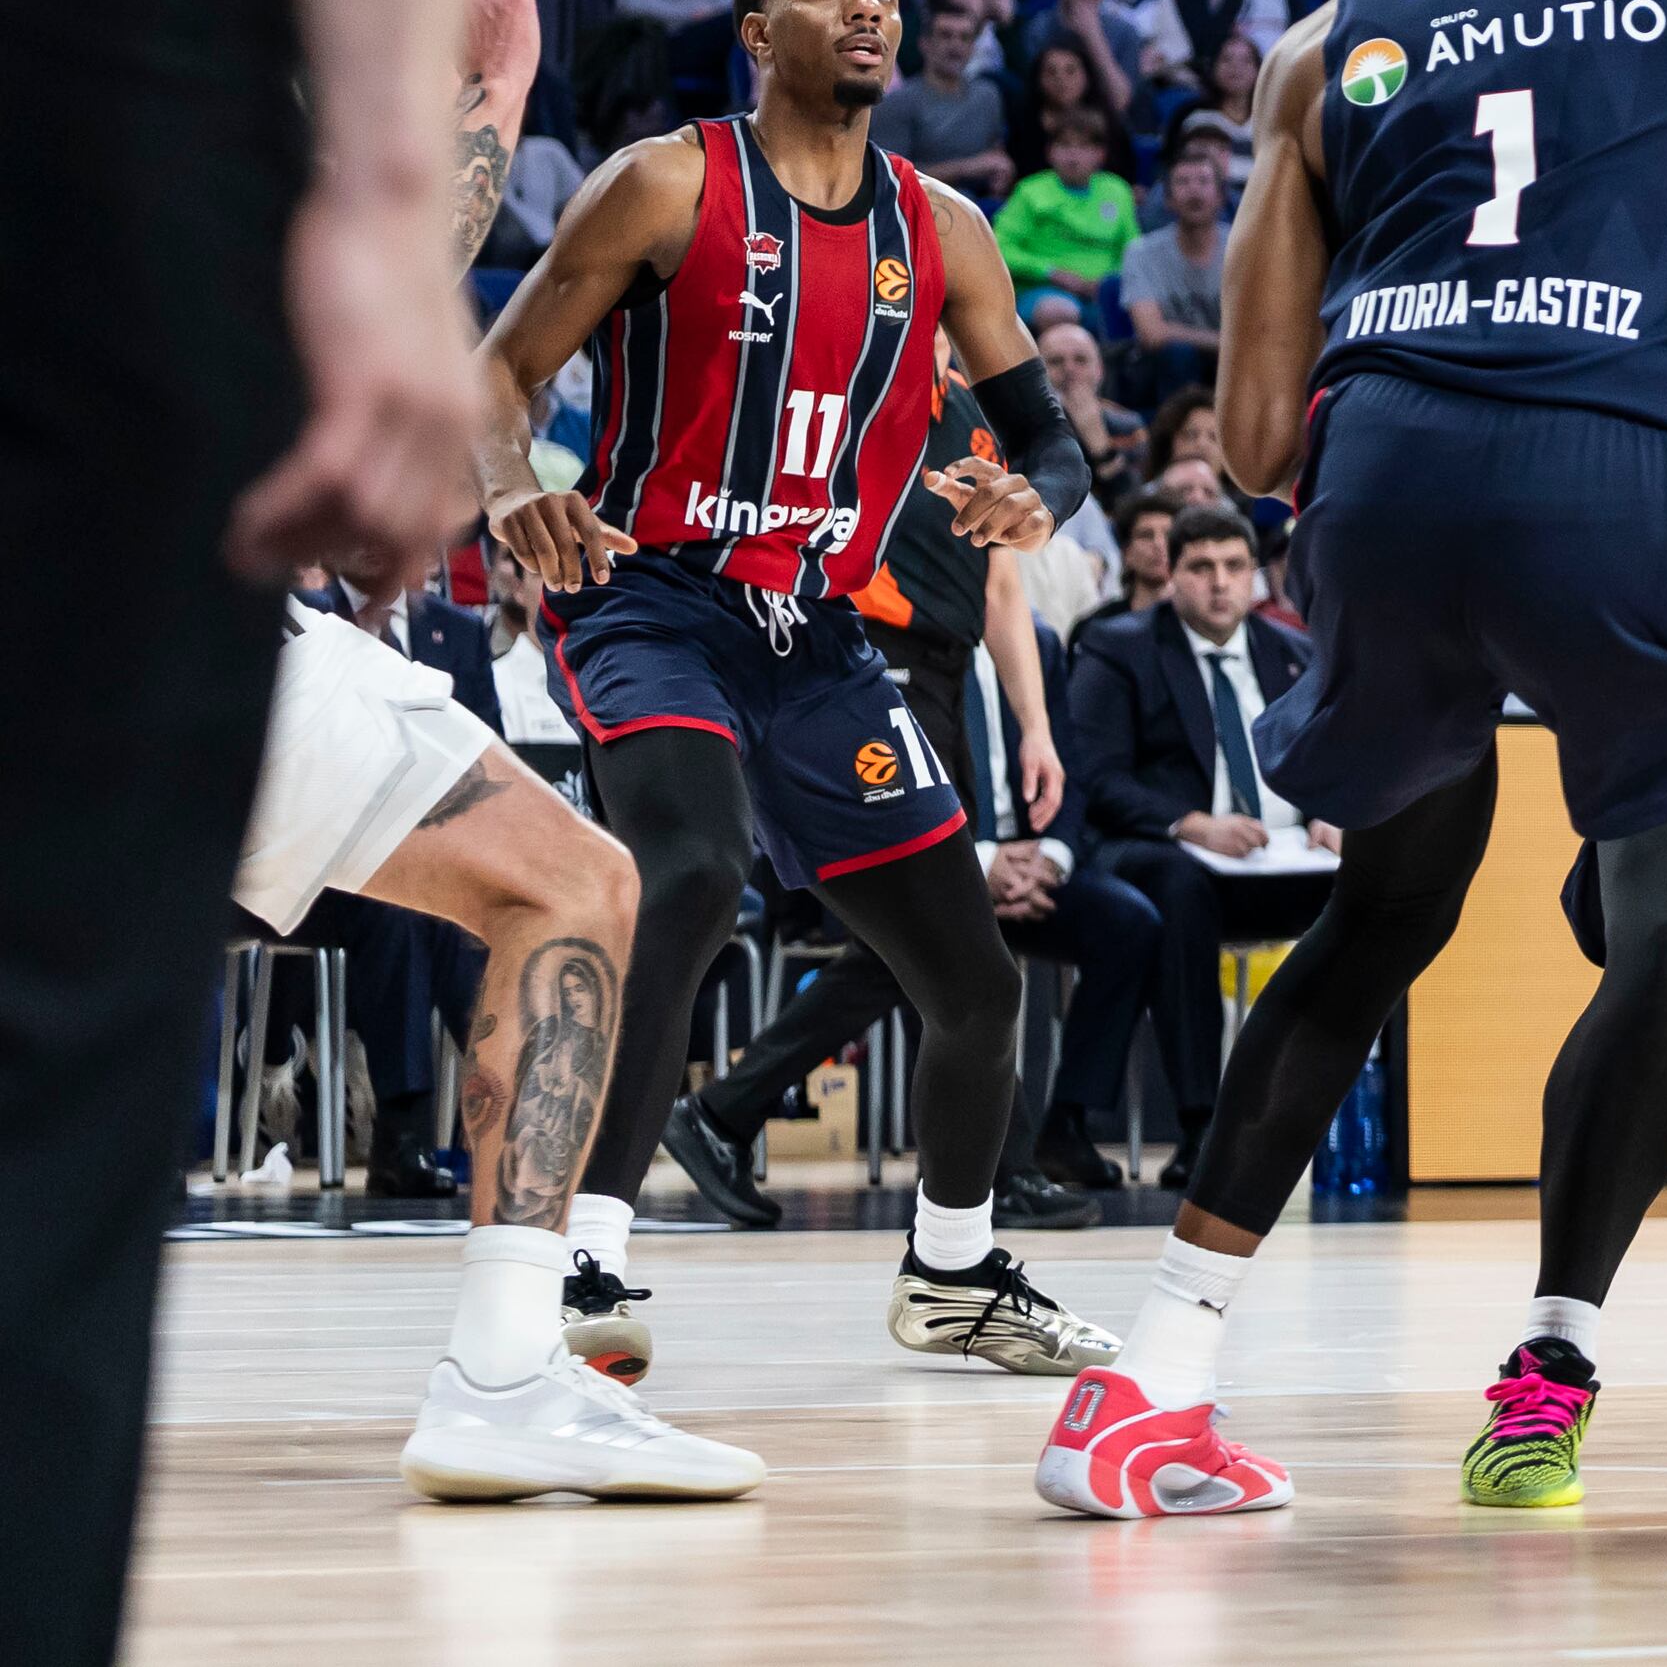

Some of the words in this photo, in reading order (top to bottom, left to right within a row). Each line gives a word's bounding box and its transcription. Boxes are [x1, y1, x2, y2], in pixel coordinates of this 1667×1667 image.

[1429, 7, 1480, 29] GRUPO
[1464, 88, 1538, 248] 1
[1345, 276, 1643, 341] VITORIA-GASTEIZ
[781, 389, 846, 479] 11
